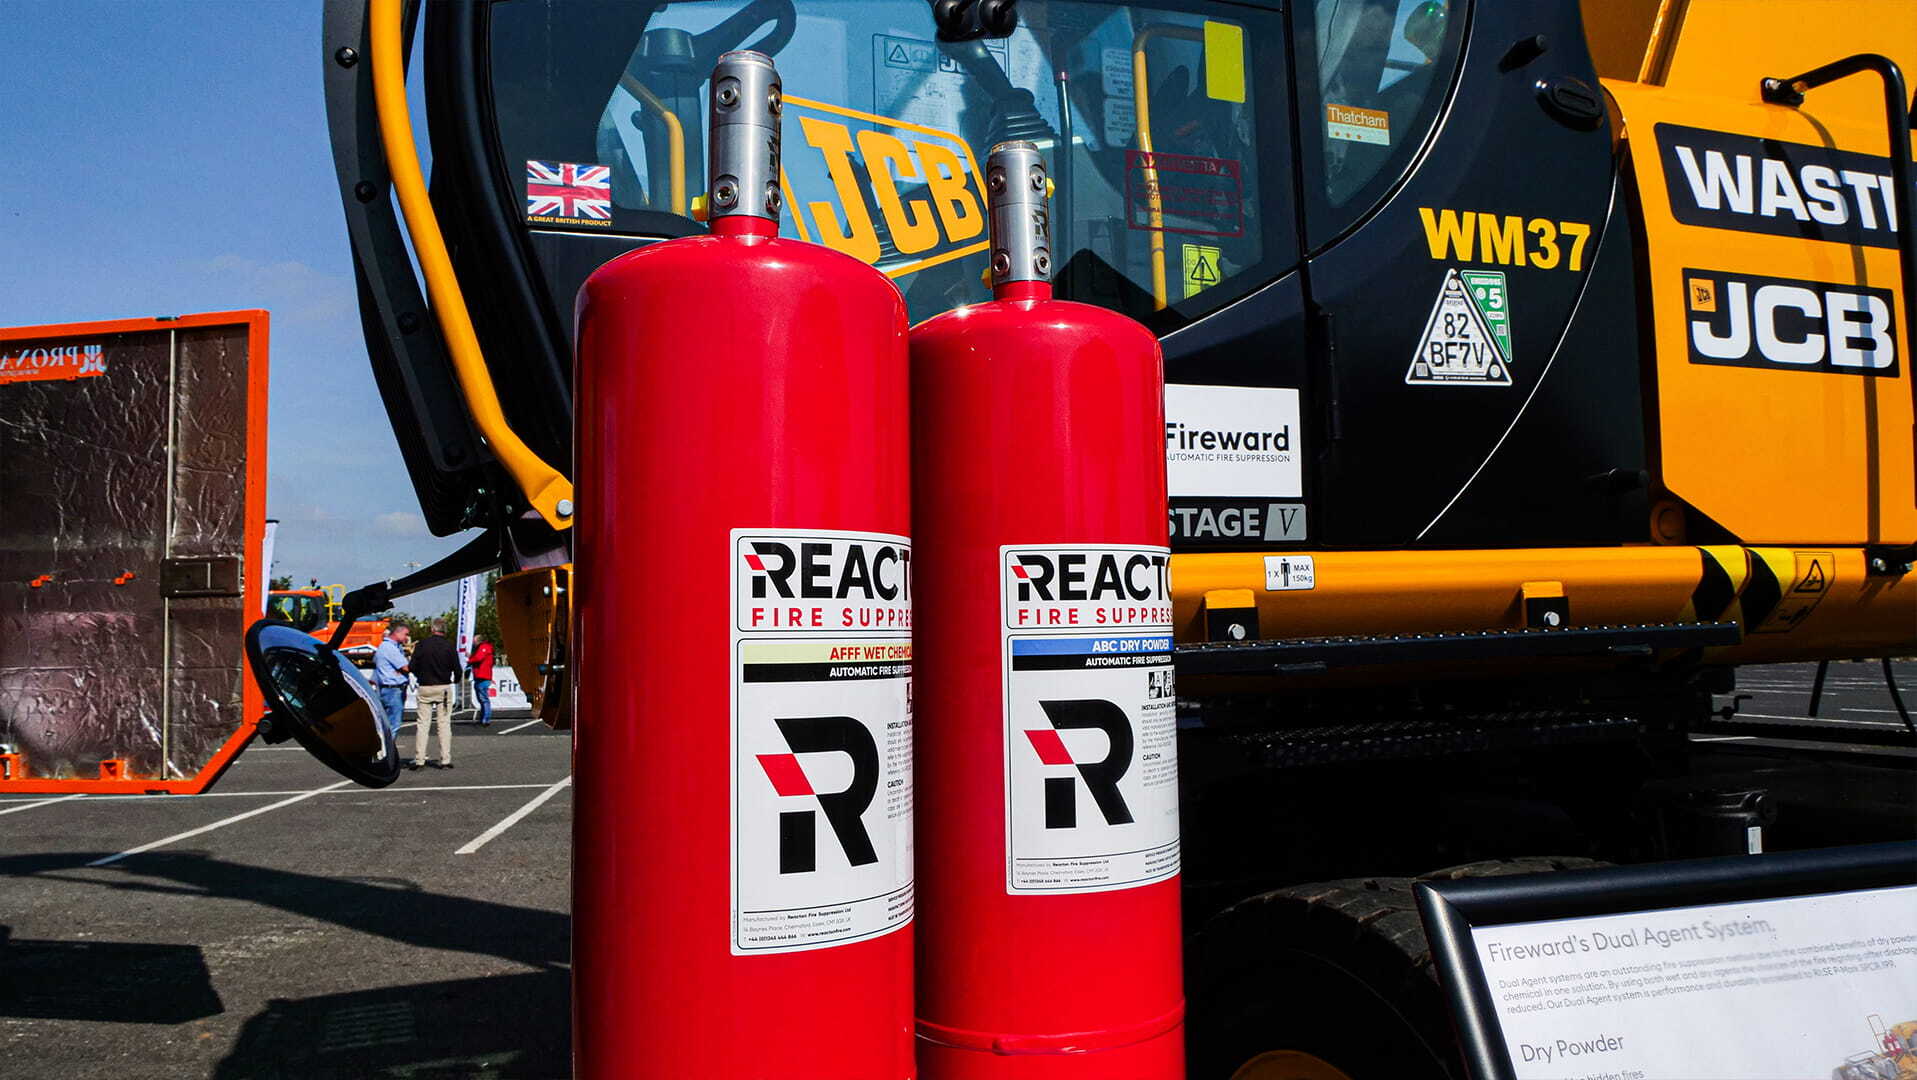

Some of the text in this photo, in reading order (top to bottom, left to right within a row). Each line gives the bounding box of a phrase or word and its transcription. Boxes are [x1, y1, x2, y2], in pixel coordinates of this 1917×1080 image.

[1328, 107, 1386, 128] Thatcham
[799, 116, 984, 265] JCB
[555, 217, 580, 225] BRITISH
[581, 219, 612, 227] PRODUCT
[1418, 207, 1591, 272] WM37
[1488, 287, 1503, 309] 5
[1444, 312, 1470, 339] 82
[1692, 281, 1894, 369] JCB
[1430, 341, 1485, 368] BF7V
[1166, 423, 1290, 452] Fireward
[1167, 453, 1290, 463] UTOMATIC FIRE SUPPRESSION
[1279, 508, 1299, 537] V
[744, 542, 912, 601] REACT
[1293, 564, 1311, 572] MAX
[1292, 575, 1313, 584] 150kg
[752, 607, 823, 627] FIRE
[1018, 608, 1079, 625] FIRE
[830, 646, 861, 660] AFFF
[863, 646, 885, 659] WET
[1092, 639, 1169, 652] ABC DRY POWDER
[830, 665, 878, 677] AUTOMATIC
[880, 665, 891, 675] FIRE
[1085, 656, 1132, 666] AUTOMATIC
[1132, 656, 1145, 665] FIRE
[1487, 935, 1590, 962] Fireward's
[1592, 929, 1639, 951] Dual
[1644, 923, 1703, 948] Agent
[1499, 979, 1520, 989] Dual
[1521, 976, 1548, 988] Agent
[1549, 973, 1583, 984] systems
[1503, 987, 1542, 1001] chemical
[1554, 987, 1570, 996] one
[1507, 1000, 1547, 1014] reduced.
[1564, 997, 1584, 1007] Dual
[1587, 994, 1613, 1005] Agent
[1520, 1034, 1624, 1063] Dry Powder
